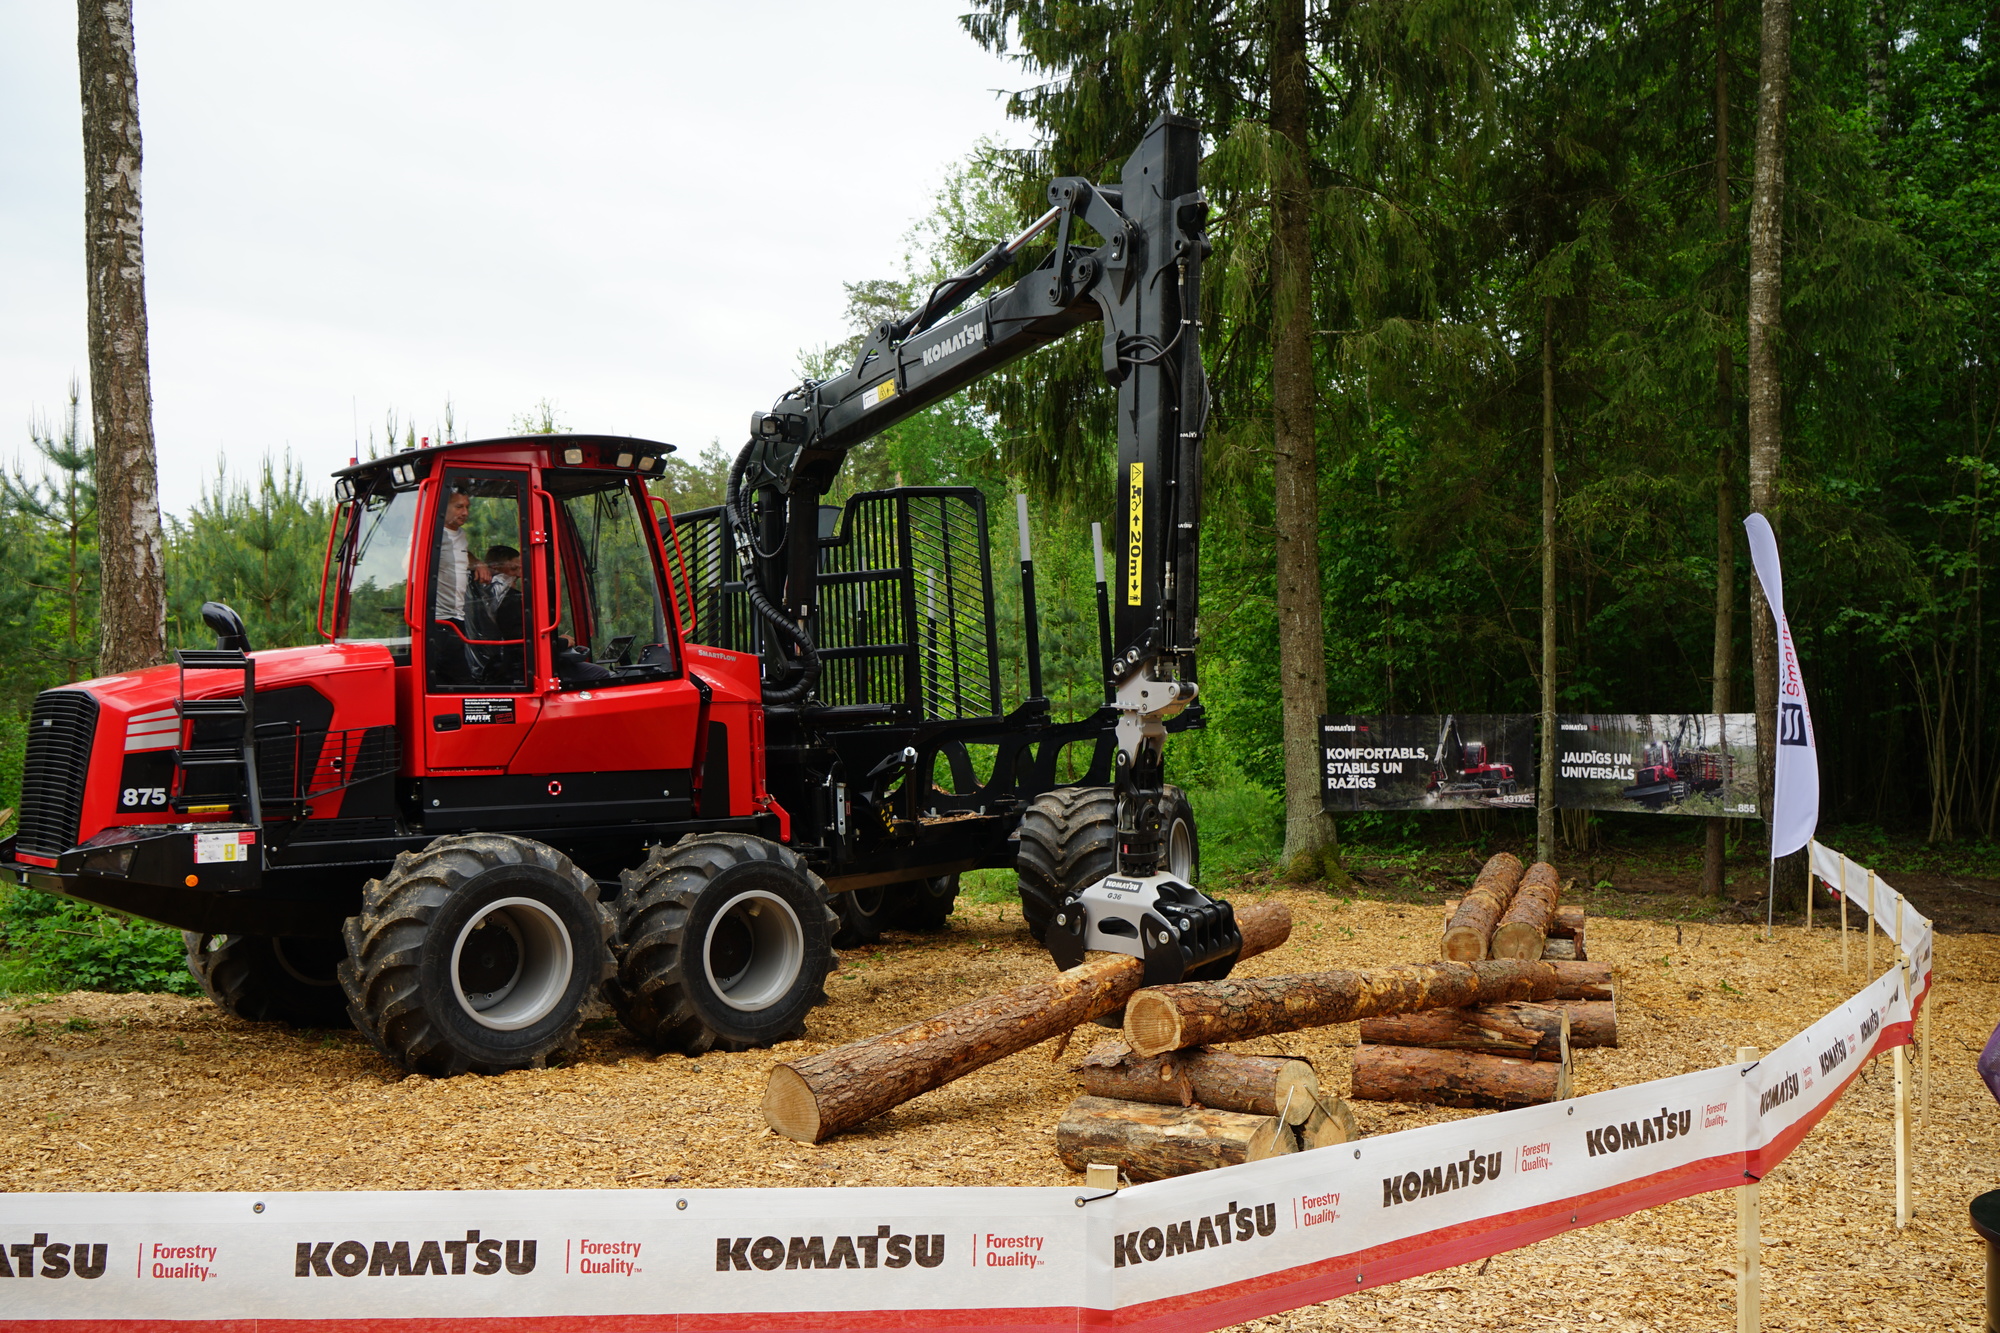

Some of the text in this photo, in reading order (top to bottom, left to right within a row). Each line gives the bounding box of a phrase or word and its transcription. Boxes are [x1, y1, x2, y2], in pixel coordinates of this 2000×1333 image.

[922, 322, 984, 367] KOMATSU
[1130, 530, 1141, 577] 20m
[1325, 724, 1356, 732] KOMATSU
[1561, 723, 1588, 731] KOMATSU
[1326, 747, 1429, 761] KOMFORTABLS,
[1561, 750, 1632, 765] JAUDĪGS UN
[1327, 762, 1403, 775] STABILS UN
[1561, 765, 1635, 780] UNIVERSĀLS
[1328, 774, 1377, 789] RAŽĪGS
[122, 787, 167, 807] 875
[1503, 794, 1531, 804] 931XC
[1738, 803, 1756, 814] 855
[1105, 880, 1140, 891] KOMATSU
[1107, 892, 1122, 901] G36
[1818, 1037, 1847, 1078] KOMATSU
[1760, 1071, 1799, 1117] KOMATSU
[1706, 1102, 1727, 1116] Forestry
[1586, 1107, 1691, 1158] KOMATSU
[1522, 1142, 1551, 1158] Forestry
[1383, 1149, 1502, 1208] KOMATSU
[1302, 1192, 1341, 1210] Forestry
[986, 1233, 1044, 1251] Forestry
[1114, 1201, 1277, 1269] KOMATSU
[152, 1243, 218, 1263] Forestry
[295, 1229, 537, 1277] KOMATSU
[580, 1239, 642, 1258] Forestry
[716, 1225, 945, 1271] KOMATSU
